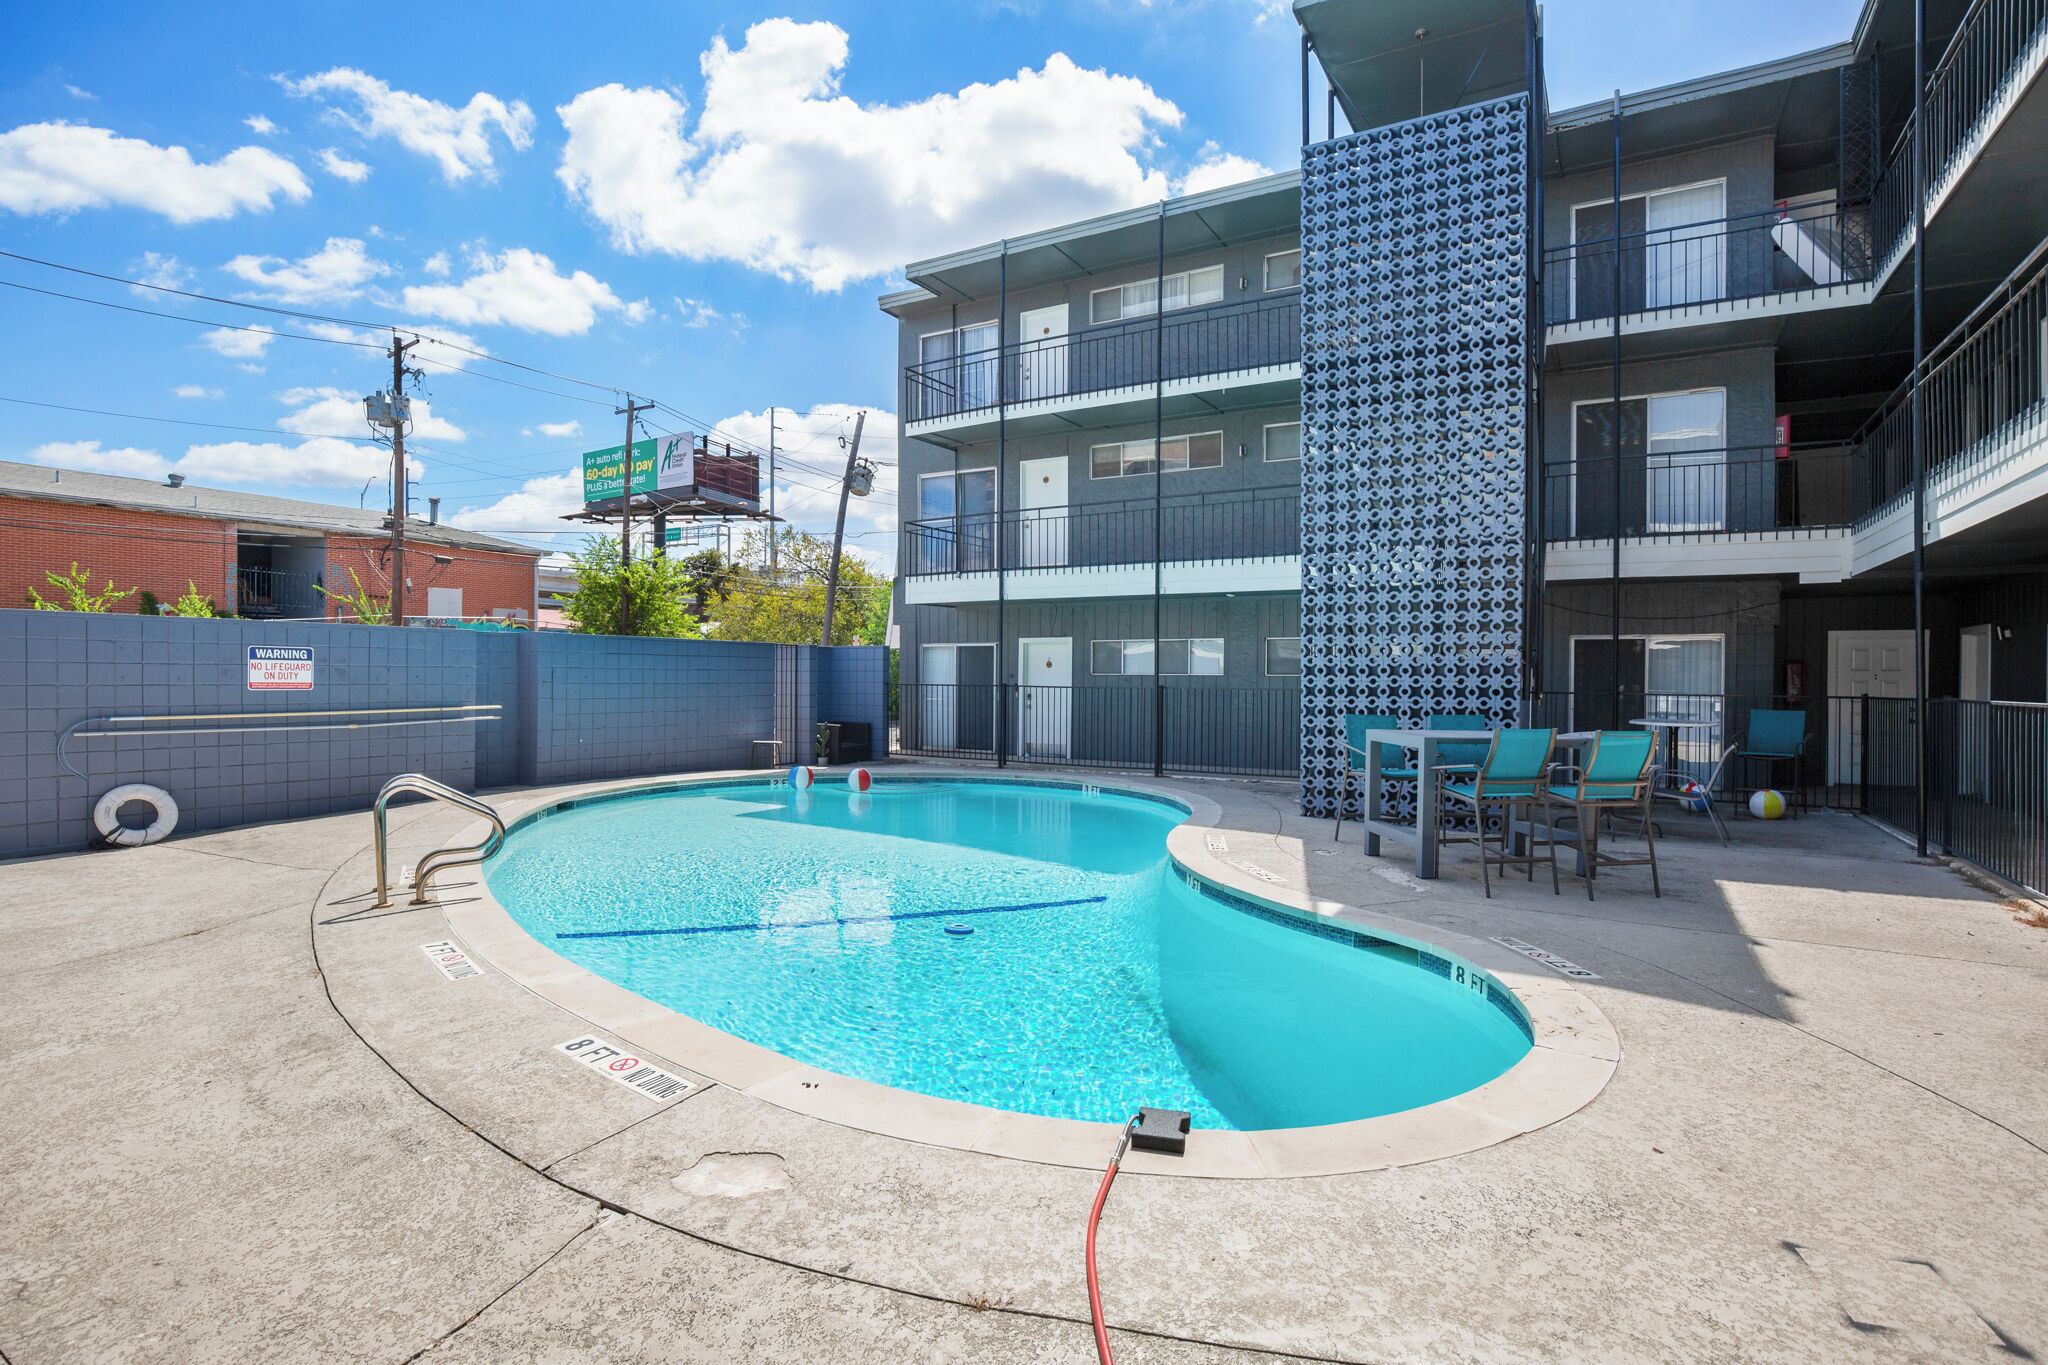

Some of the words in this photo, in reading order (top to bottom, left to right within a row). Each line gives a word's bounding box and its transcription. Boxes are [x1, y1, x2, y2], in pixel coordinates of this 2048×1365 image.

[586, 457, 595, 466] A+
[596, 453, 611, 464] auto
[611, 449, 623, 461] refi
[624, 447, 641, 460] rk:
[661, 438, 683, 474] A+
[586, 465, 618, 481] 60-day
[586, 481, 603, 492] PLUS
[608, 477, 627, 488] bette
[255, 648, 308, 660] WARNING
[250, 662, 263, 671] NO
[265, 662, 312, 672] LIFEGUARD
[263, 671, 276, 680] ON
[277, 671, 299, 680] DUTY
[430, 947, 457, 957] FT
[1455, 965, 1465, 985] 8
[1470, 972, 1486, 995] FT
[565, 1039, 595, 1051] 8
[579, 1046, 621, 1063] FT
[621, 1067, 655, 1083] NO
[636, 1074, 689, 1099] DIVING
